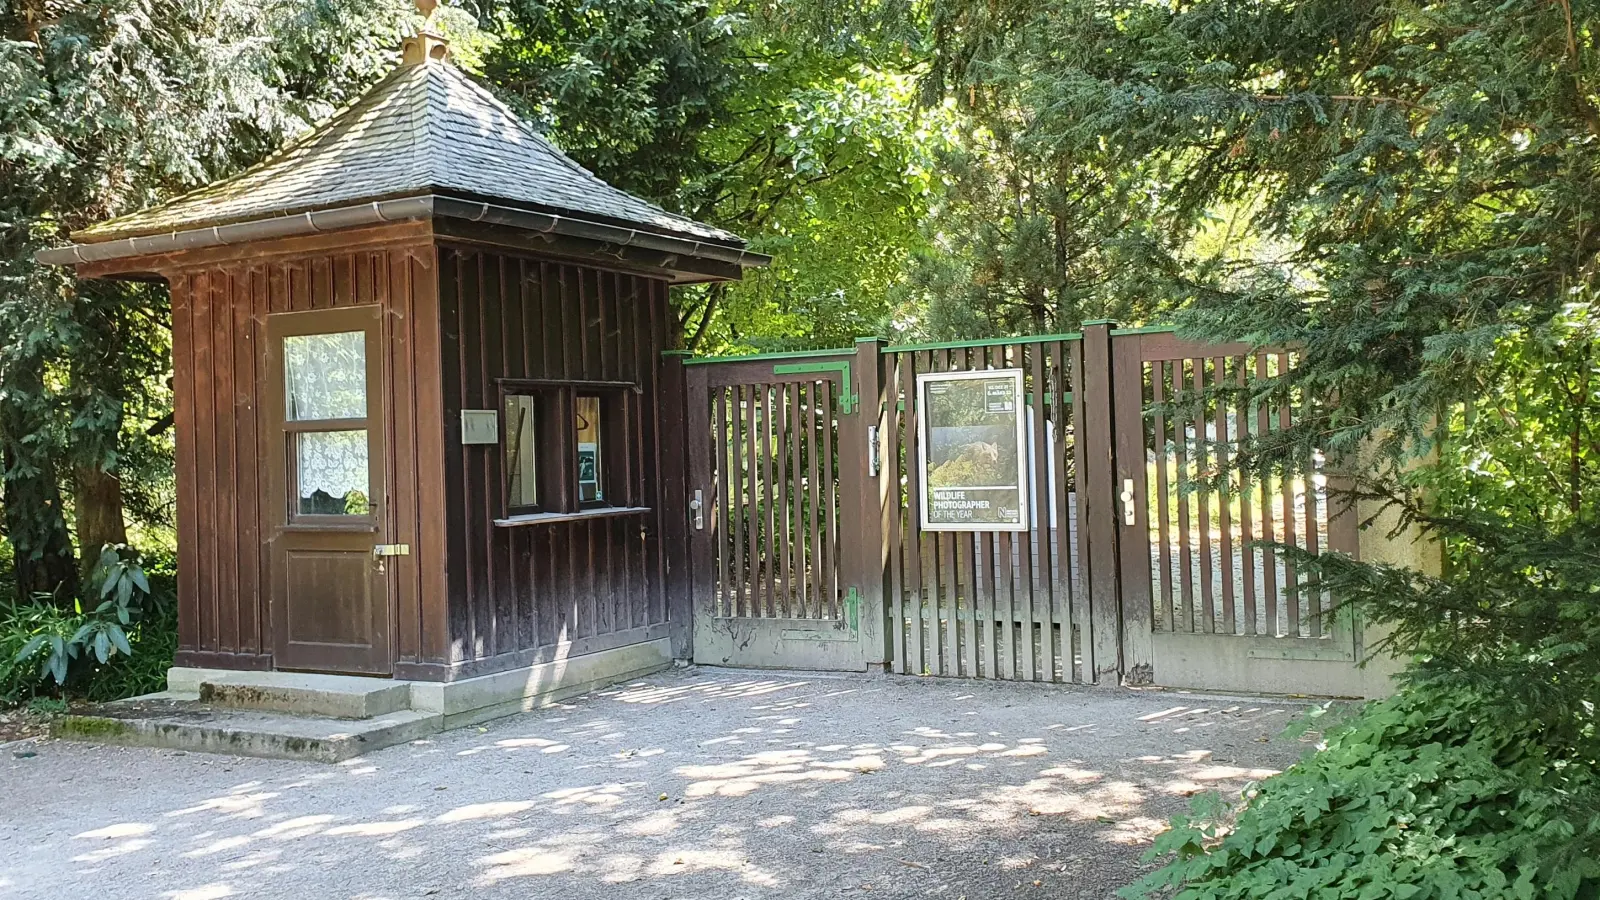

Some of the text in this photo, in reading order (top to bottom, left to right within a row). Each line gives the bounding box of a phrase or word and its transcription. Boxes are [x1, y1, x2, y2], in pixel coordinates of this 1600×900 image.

[934, 491, 965, 500] WILDLIFE
[933, 501, 990, 509] PHOTOGRAPHER
[933, 510, 973, 518] OF THE YEAR
